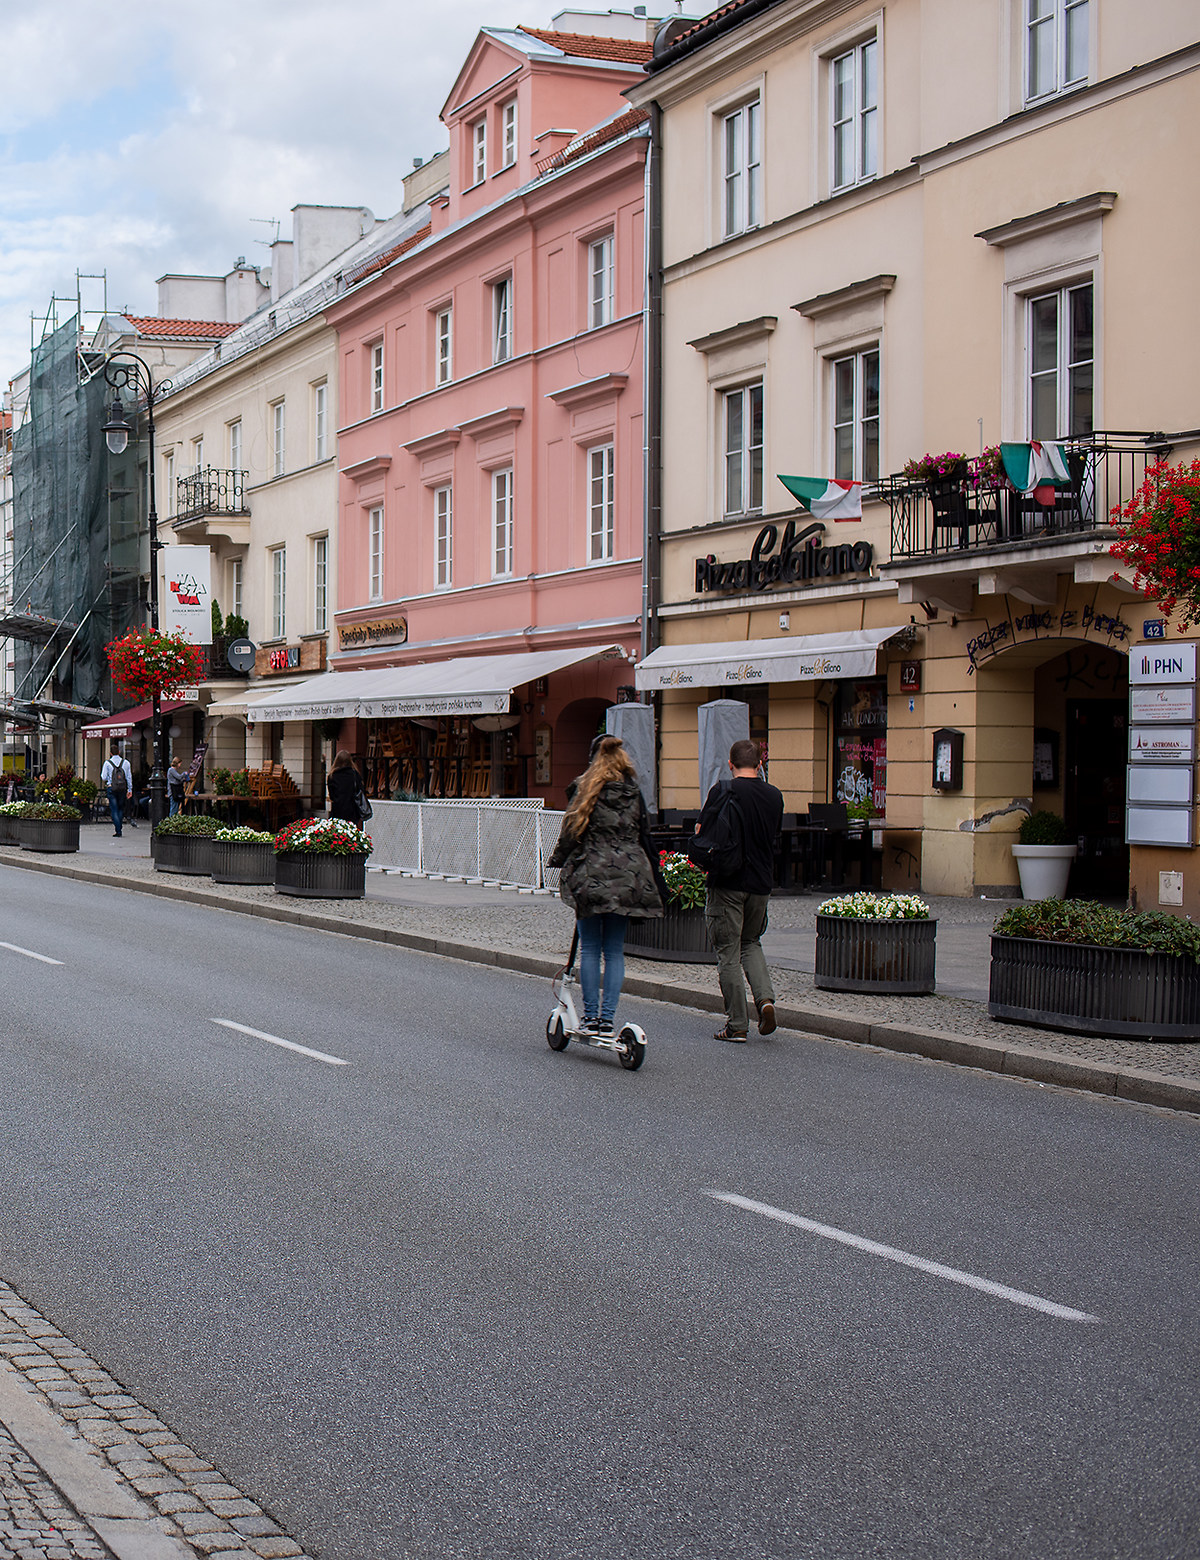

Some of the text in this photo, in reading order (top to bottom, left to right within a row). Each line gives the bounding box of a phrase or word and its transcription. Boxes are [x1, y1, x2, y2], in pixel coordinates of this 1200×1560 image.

[1146, 626, 1161, 637] 42
[1154, 657, 1184, 674] PHN
[903, 667, 917, 684] 42
